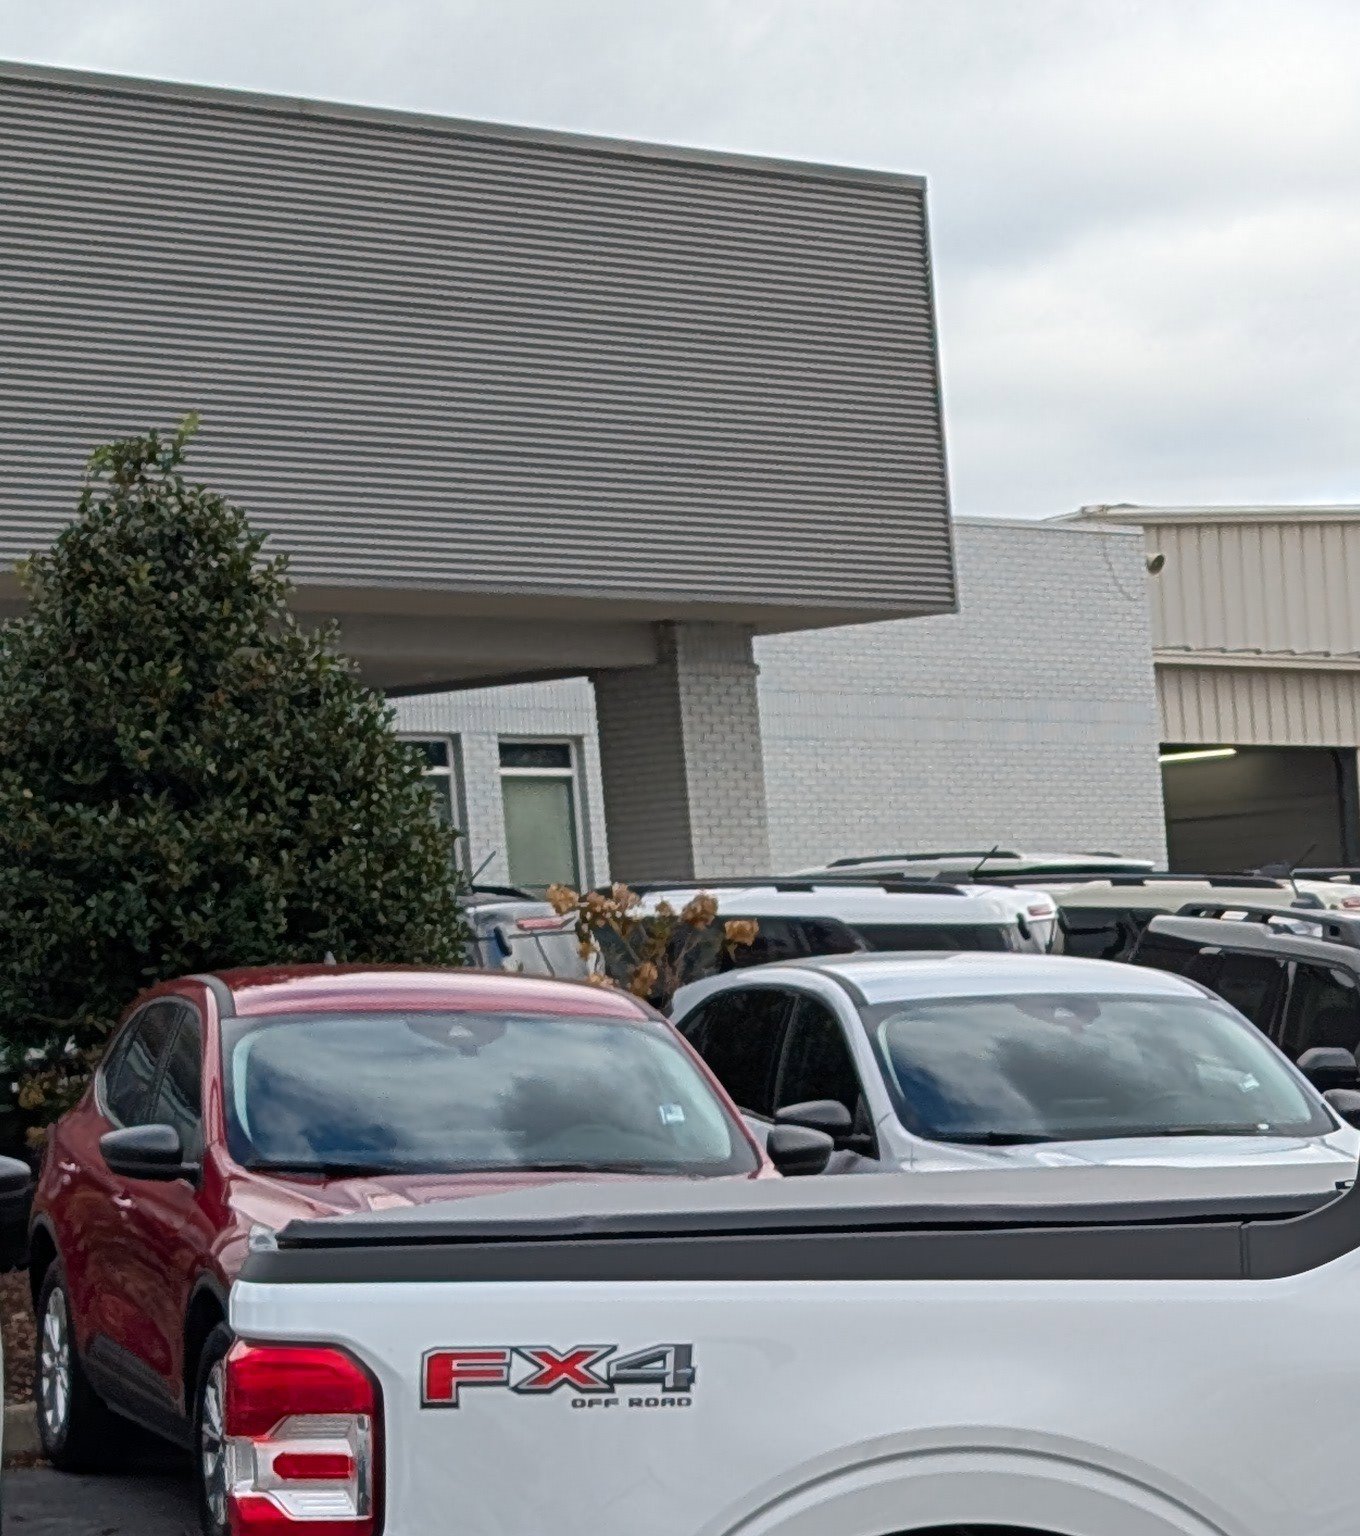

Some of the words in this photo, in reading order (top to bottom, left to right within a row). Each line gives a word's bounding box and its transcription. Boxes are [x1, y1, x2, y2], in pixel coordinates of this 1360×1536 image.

[420, 1343, 698, 1409] FX4
[571, 1397, 620, 1409] OFF
[628, 1396, 692, 1408] ROAD
